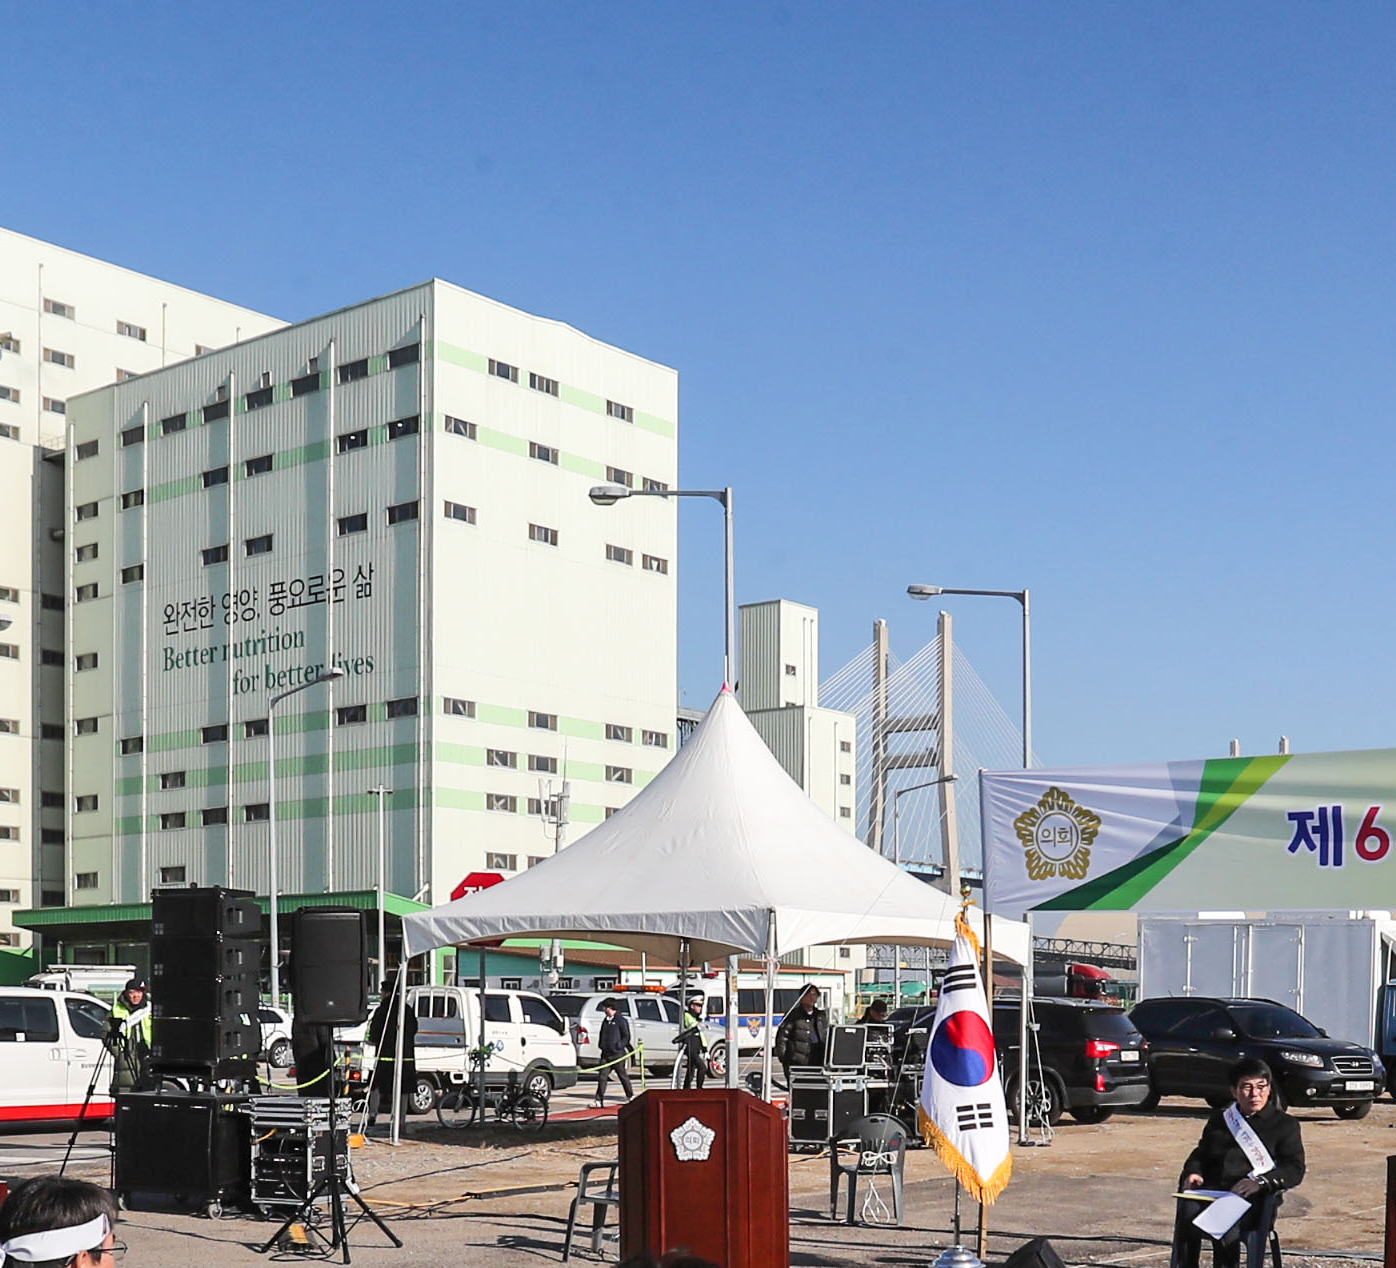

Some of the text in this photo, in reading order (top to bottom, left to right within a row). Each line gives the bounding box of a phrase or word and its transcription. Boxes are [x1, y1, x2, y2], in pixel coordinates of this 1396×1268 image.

[163, 562, 374, 636] 완전한 영양, 풍요로운 삶
[163, 626, 305, 672] Better nutrition
[233, 669, 259, 695] for
[265, 663, 324, 690] better
[1041, 825, 1075, 848] 의회
